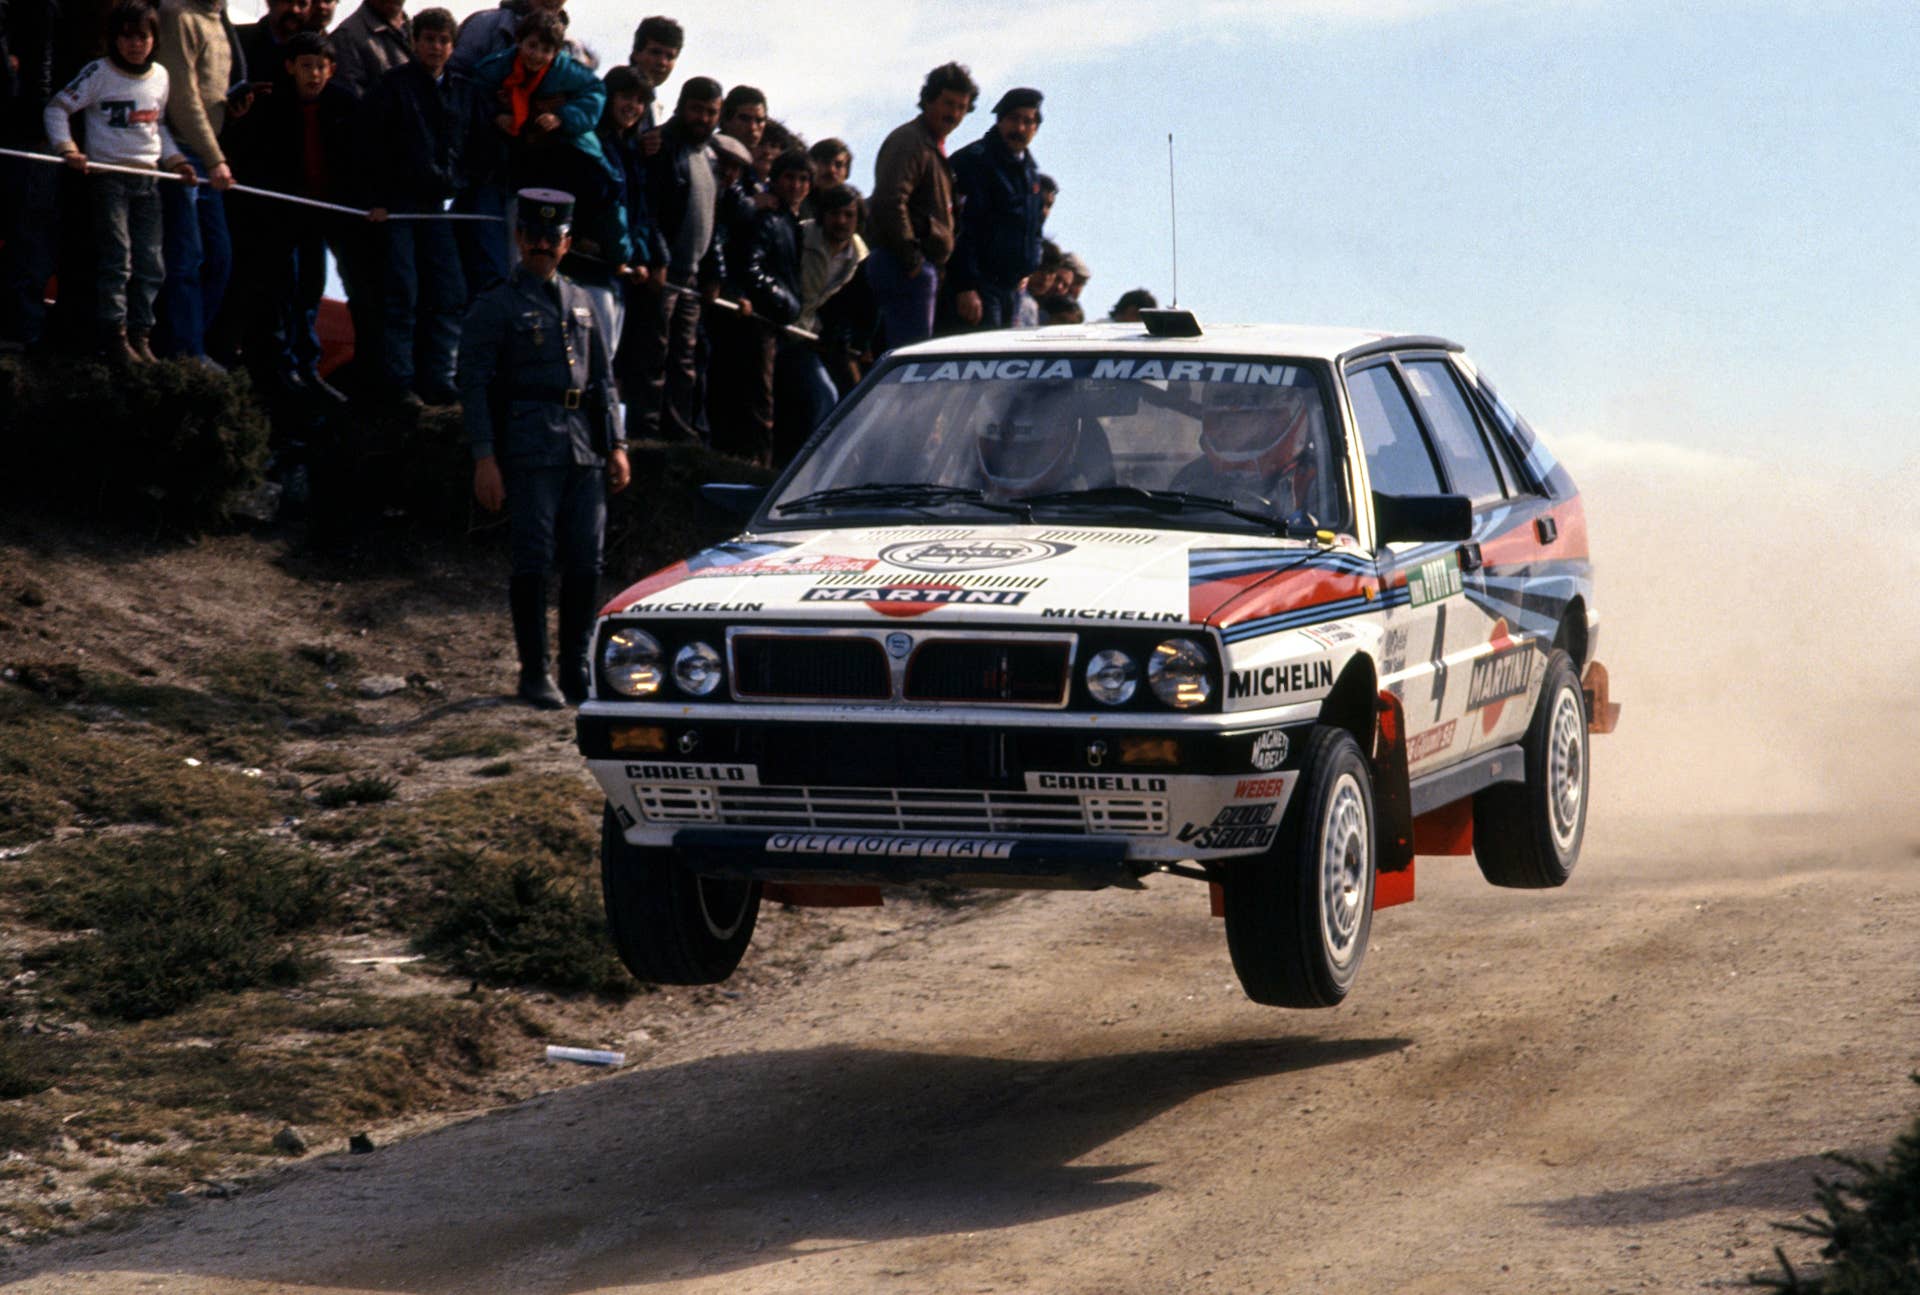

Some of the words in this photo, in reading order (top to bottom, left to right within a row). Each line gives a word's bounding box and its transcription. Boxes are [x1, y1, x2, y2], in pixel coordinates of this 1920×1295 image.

[901, 359, 1073, 383] LANCIA
[1092, 360, 1297, 386] MARTINI
[811, 588, 1018, 604] MARTINI
[630, 602, 763, 613] MICHELIN
[1041, 607, 1184, 623] MICHELIN
[1228, 660, 1333, 698] MICHELIN
[1470, 648, 1533, 705] MARTINI
[625, 764, 744, 781] CARELLO
[1039, 774, 1167, 792] CARELLO
[1234, 778, 1284, 798] WEBER
[1217, 806, 1273, 824] OLIO
[1216, 829, 1275, 846] FIAT
